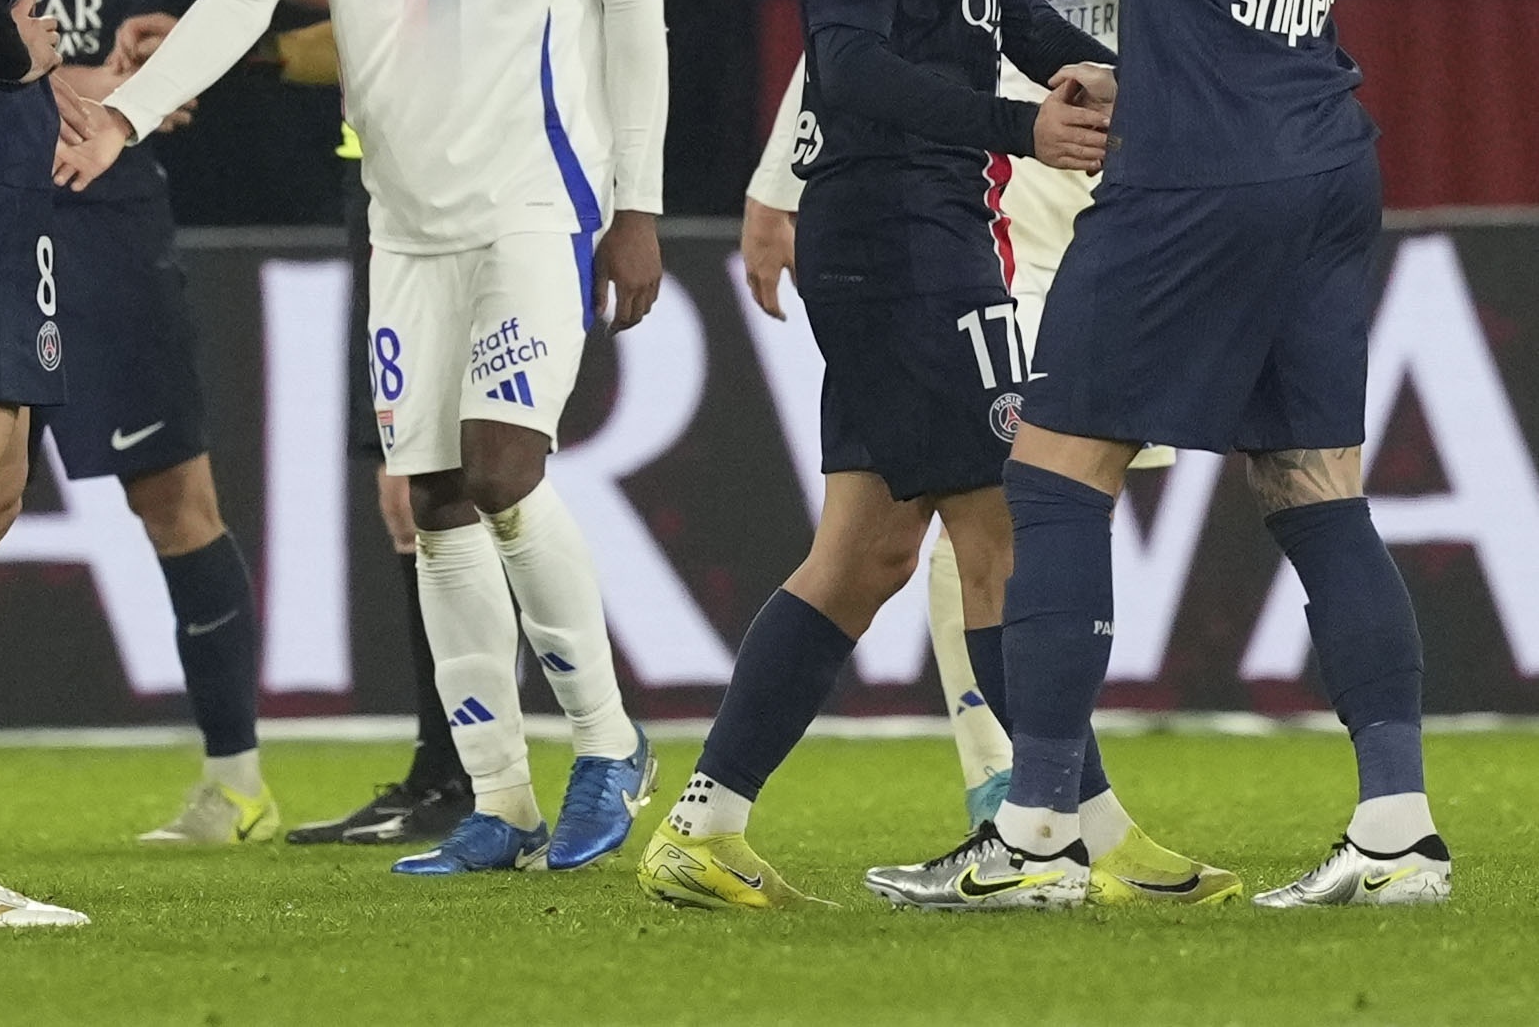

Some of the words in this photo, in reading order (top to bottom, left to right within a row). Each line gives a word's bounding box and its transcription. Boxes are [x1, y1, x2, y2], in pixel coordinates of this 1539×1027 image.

[36, 235, 57, 317] 8
[368, 327, 404, 401] 8
[471, 336, 548, 384] match
[472, 317, 520, 364] staff
[957, 302, 1022, 390] 17
